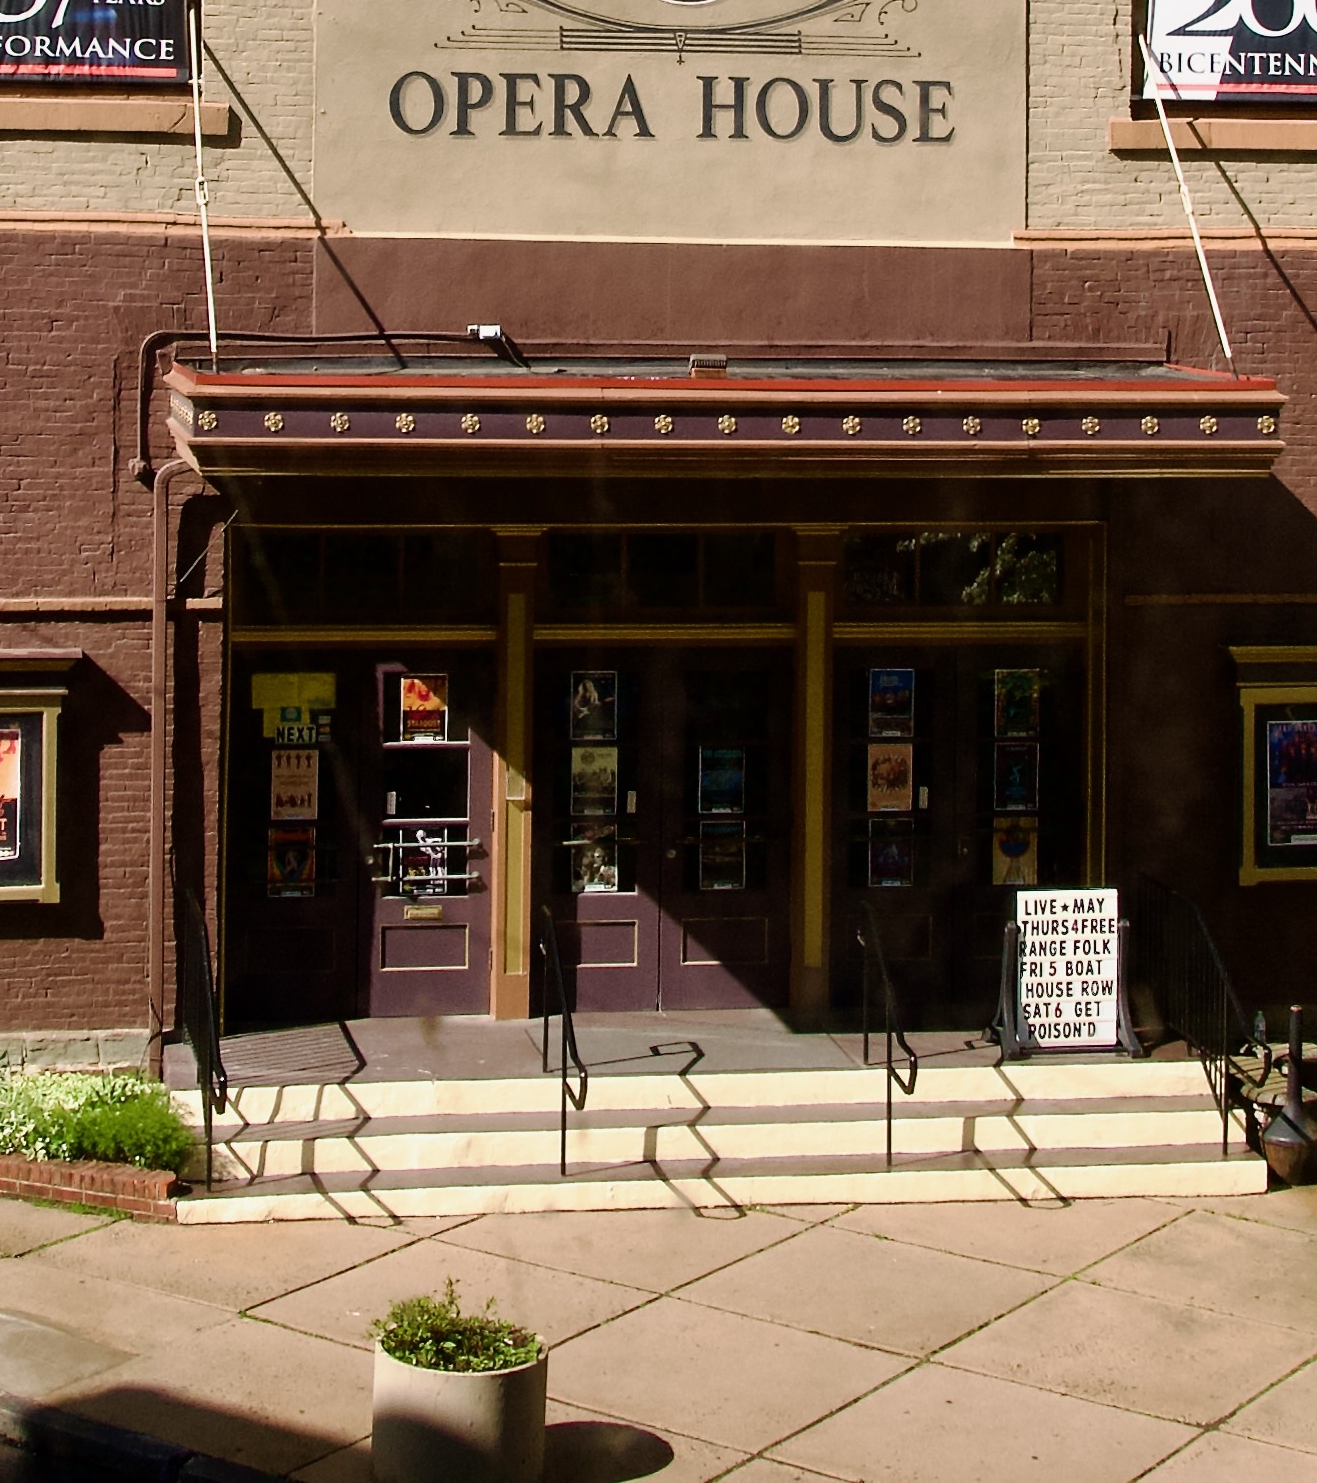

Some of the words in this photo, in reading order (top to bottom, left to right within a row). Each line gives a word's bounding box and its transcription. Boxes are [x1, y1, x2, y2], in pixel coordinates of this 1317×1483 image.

[388, 70, 657, 141] OPERA
[696, 75, 957, 144] HOUSE
[275, 726, 316, 743] NEXT
[1024, 899, 1057, 916] LIVE
[1073, 898, 1105, 914] MAY
[1021, 919, 1069, 937] THURS
[1071, 919, 1079, 935] 4
[1081, 918, 1116, 934] FREE
[1018, 940, 1067, 957] RANGE
[1073, 939, 1111, 956] FOLK
[1020, 961, 1043, 978] FRI
[1048, 961, 1057, 977] 5
[1065, 960, 1103, 977] BOAT
[1025, 981, 1074, 999] HOUSE
[1081, 980, 1114, 997] ROW
[1023, 1002, 1051, 1020] SAT
[1054, 1002, 1063, 1018] 6
[1074, 1001, 1102, 1017] GET
[1028, 1022, 1096, 1040] POISON'D
